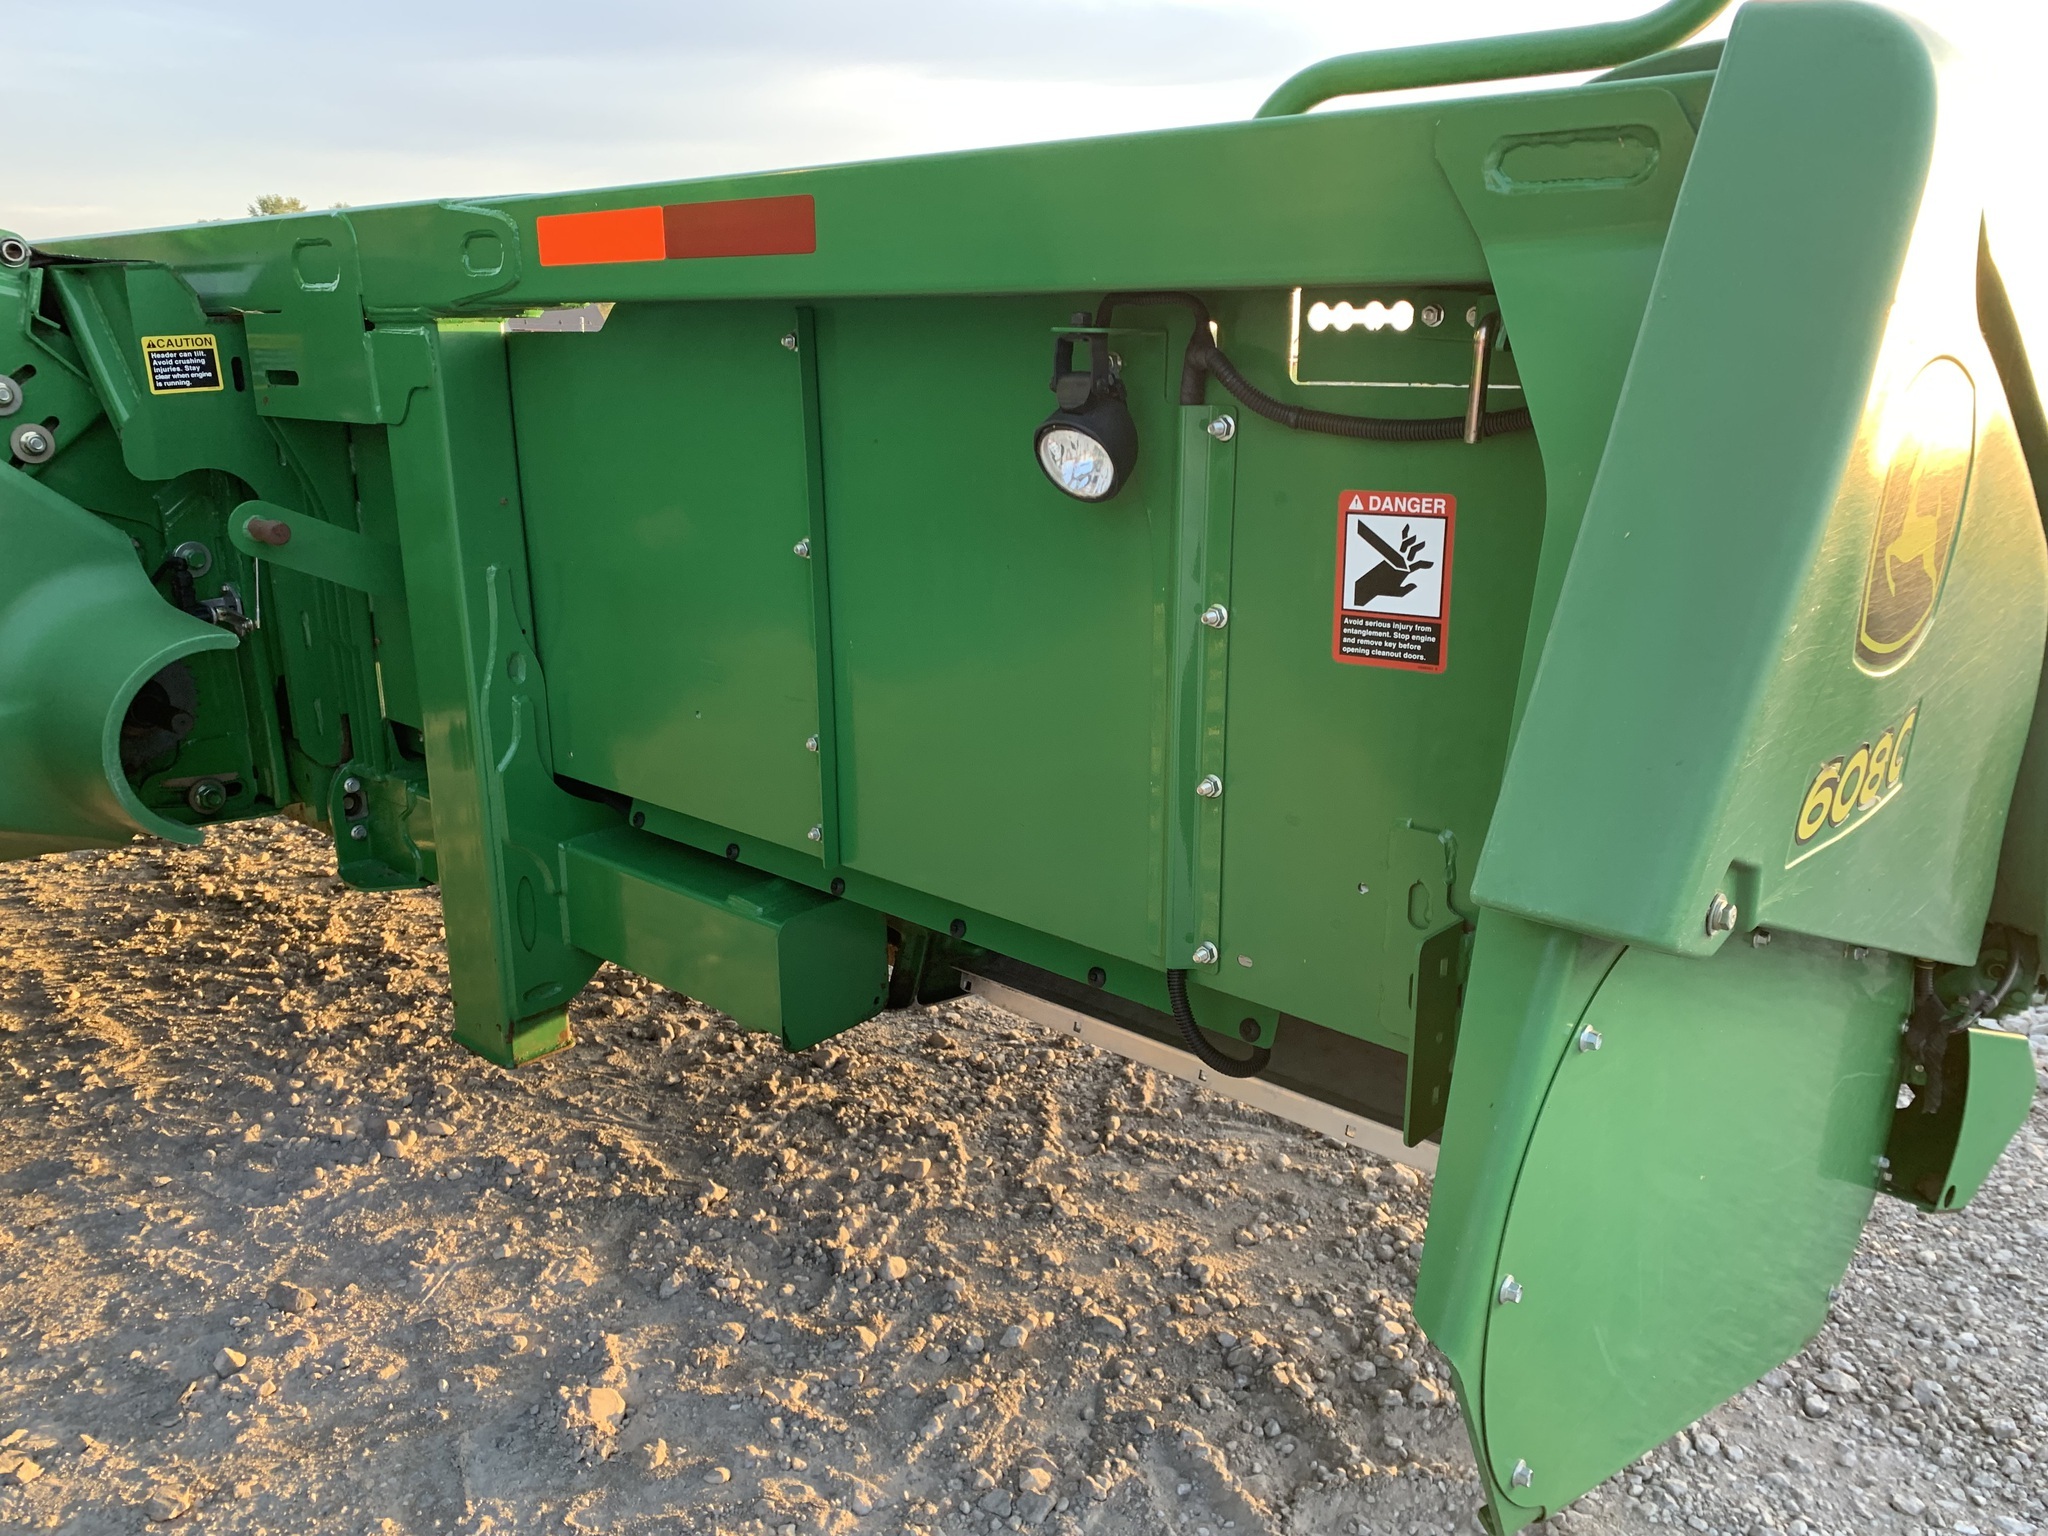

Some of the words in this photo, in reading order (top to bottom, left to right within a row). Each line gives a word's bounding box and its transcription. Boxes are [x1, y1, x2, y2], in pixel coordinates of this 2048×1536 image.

[157, 337, 212, 348] CAUTION
[191, 371, 212, 379] engine
[1369, 496, 1446, 514] DANGER
[1344, 617, 1363, 626] Avoid
[1365, 620, 1391, 628] serious
[1393, 622, 1413, 631] injury
[1415, 624, 1432, 632] from
[1343, 627, 1391, 638] entanglement.
[1393, 631, 1410, 640] Stop
[1412, 634, 1436, 643] engine
[1357, 638, 1382, 647] remove
[1384, 641, 1397, 649] key
[1399, 642, 1421, 650] before
[1342, 646, 1370, 655] opening
[1371, 649, 1402, 658] cleanout
[1403, 652, 1426, 660] doors.
